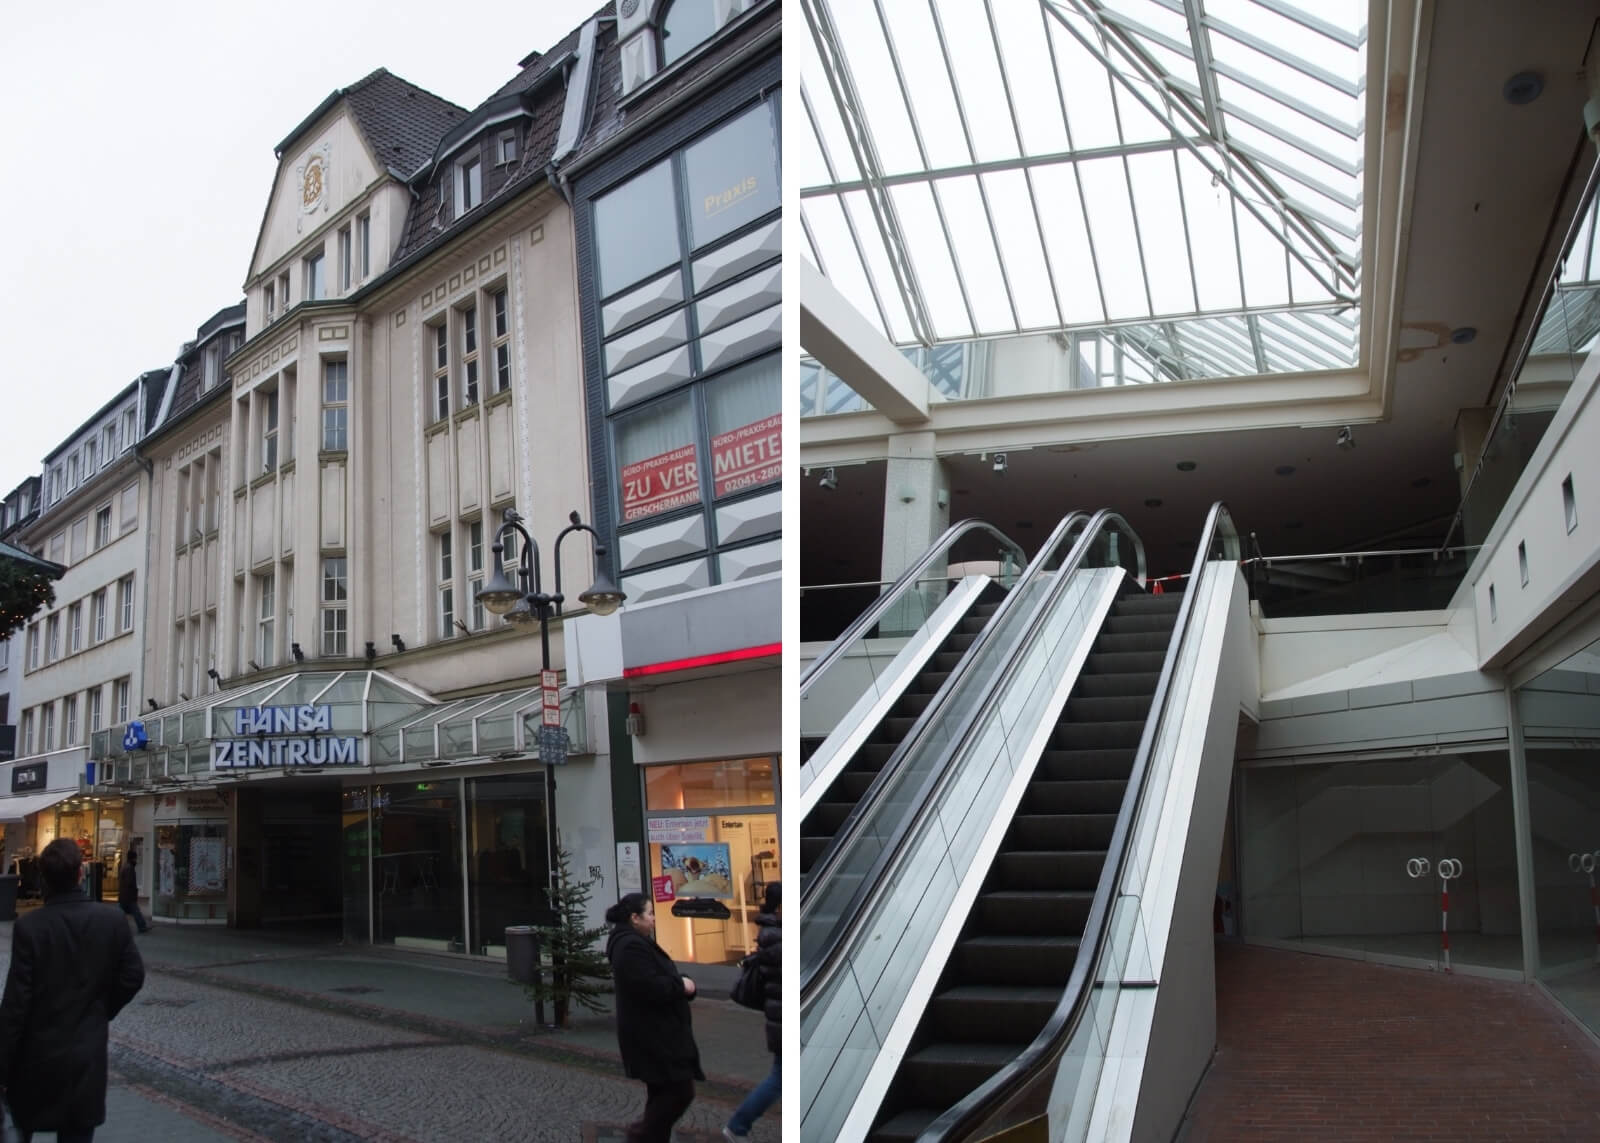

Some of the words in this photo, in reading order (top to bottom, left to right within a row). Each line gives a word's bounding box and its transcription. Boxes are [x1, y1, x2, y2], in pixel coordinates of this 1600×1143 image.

[704, 176, 758, 214] Praxis
[625, 475, 651, 502] ZU
[658, 462, 699, 491] VER
[625, 490, 700, 520] GERSCHERMANN
[235, 704, 333, 735] HANSA
[214, 736, 359, 768] ZENTRUM
